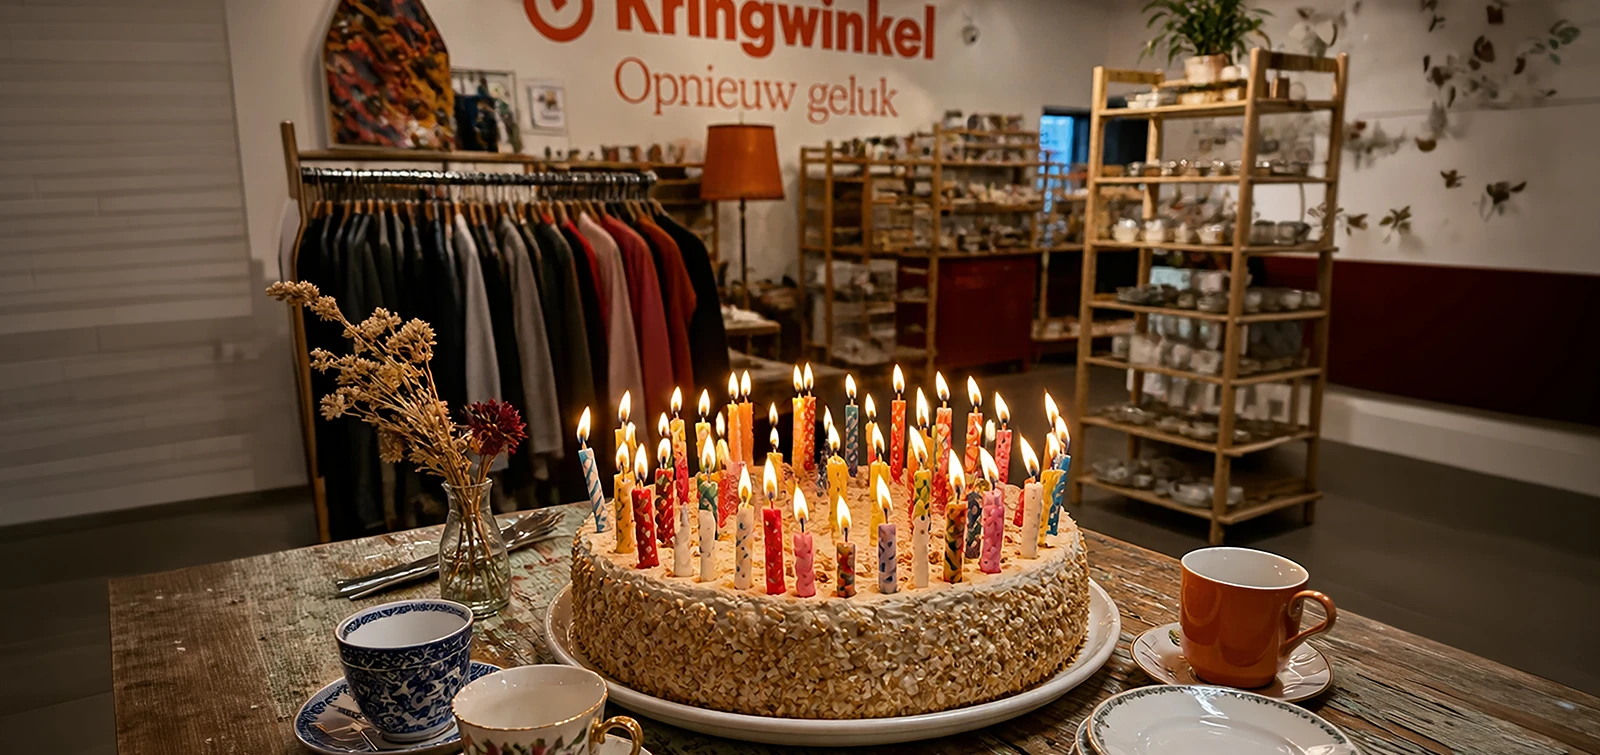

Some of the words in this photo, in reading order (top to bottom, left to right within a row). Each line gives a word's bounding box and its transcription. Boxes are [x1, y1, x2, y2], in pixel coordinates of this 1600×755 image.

[616, 0, 936, 60] Kringwinkel
[614, 56, 797, 116] Opnieuw
[807, 75, 899, 124] geluk
